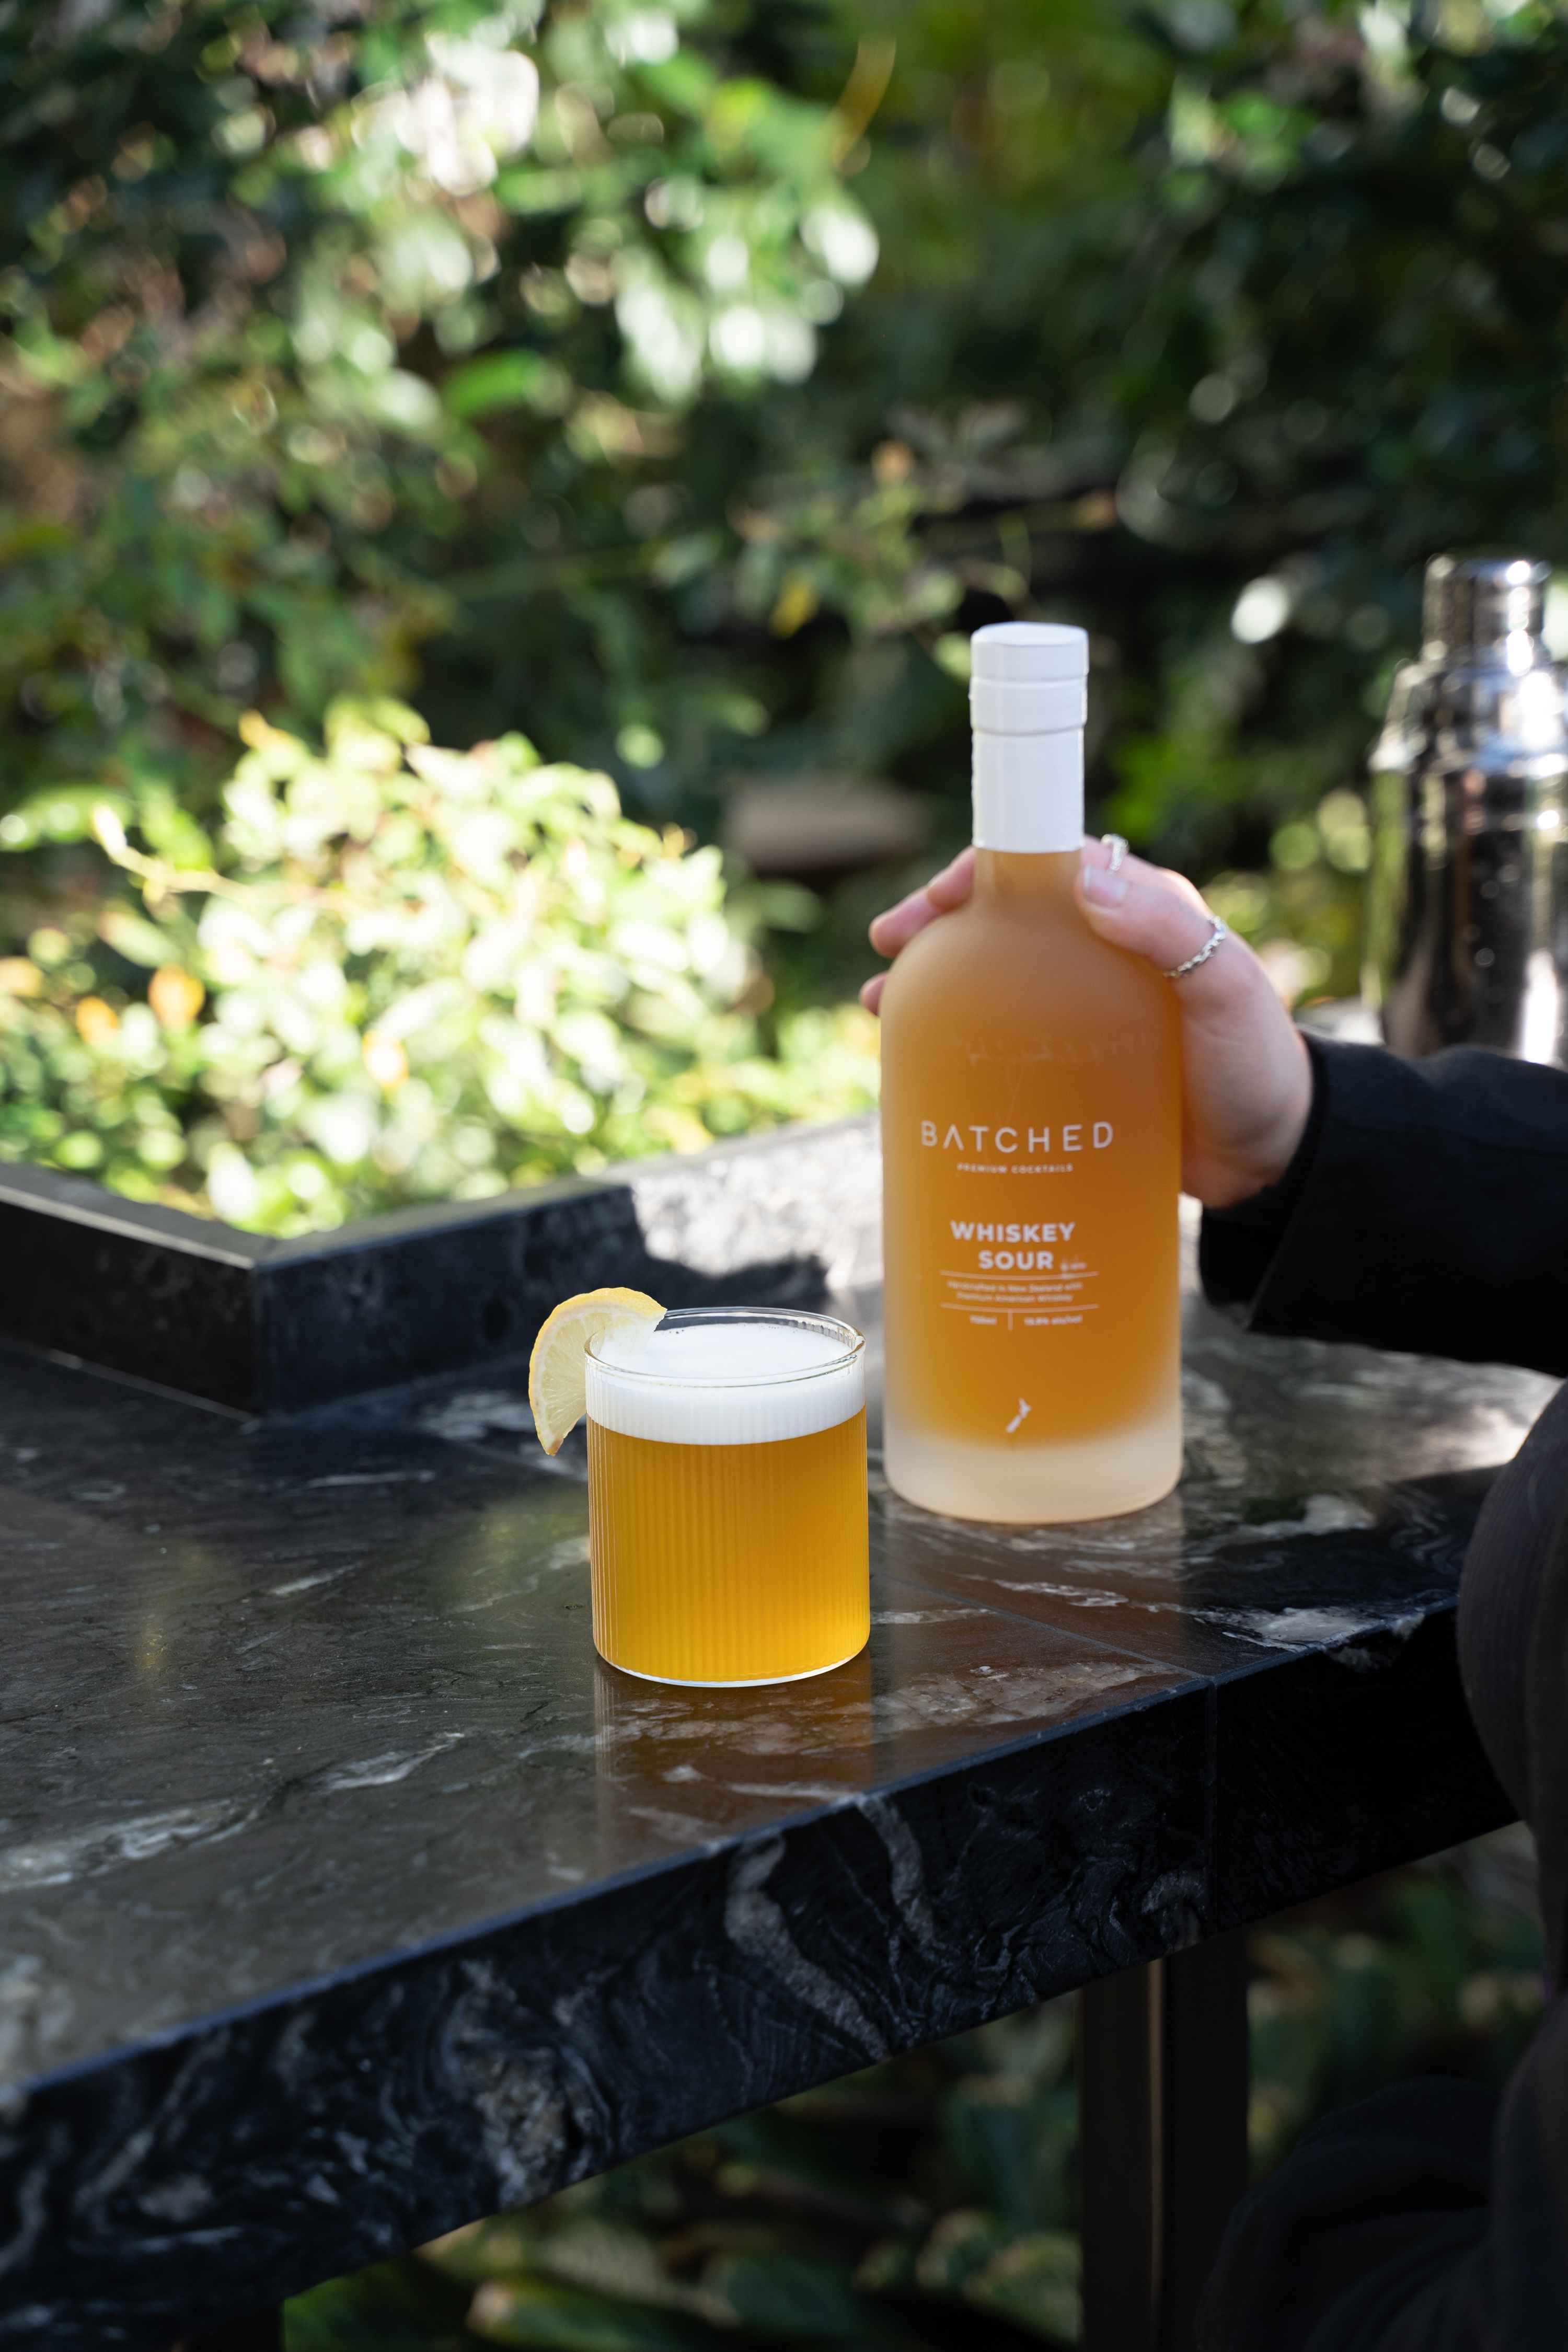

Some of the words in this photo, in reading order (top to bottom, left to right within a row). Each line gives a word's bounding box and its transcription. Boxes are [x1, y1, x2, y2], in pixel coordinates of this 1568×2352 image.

[920, 1120, 1114, 1154] BATCHED
[956, 1162, 1007, 1174] PREMIUM
[1010, 1162, 1074, 1174] COCKTAILS
[950, 1220, 1076, 1243] WHISKEY
[978, 1250, 1054, 1270] SOUR
